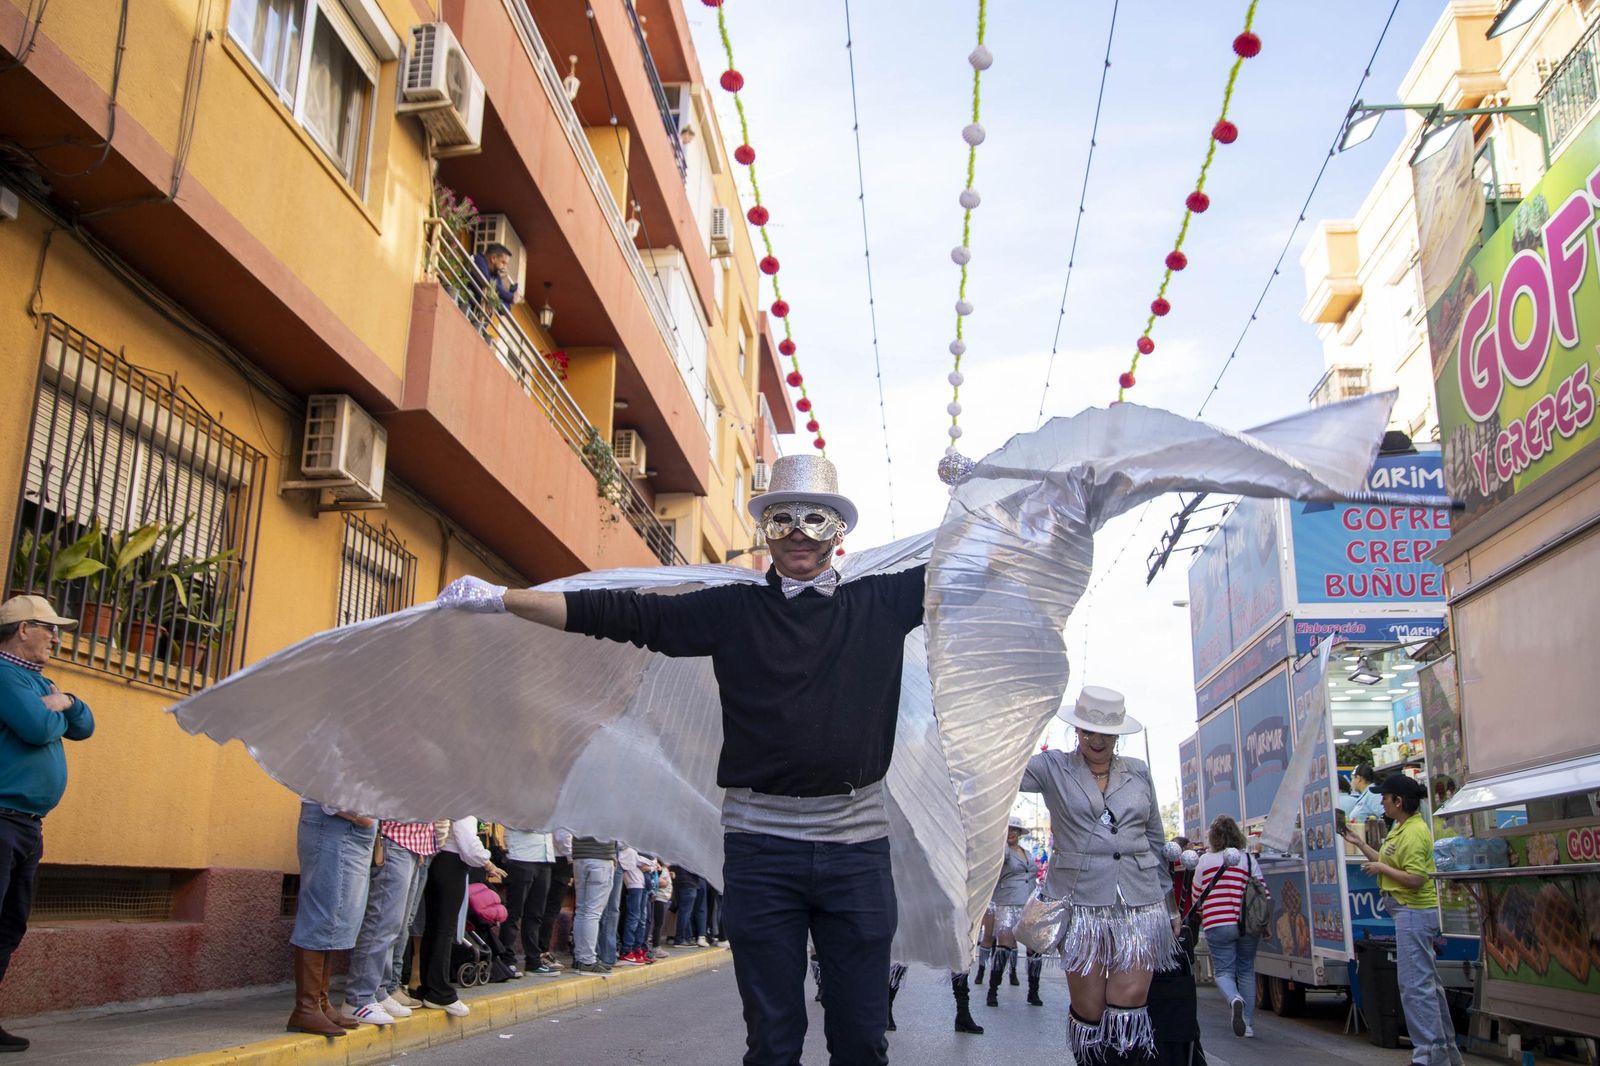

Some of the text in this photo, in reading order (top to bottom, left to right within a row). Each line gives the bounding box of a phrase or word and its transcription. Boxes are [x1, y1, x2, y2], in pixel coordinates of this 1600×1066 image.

[1458, 166, 1600, 424] GOF
[1471, 361, 1595, 498] Y CREPES
[1296, 622, 1366, 634] Elaboración
